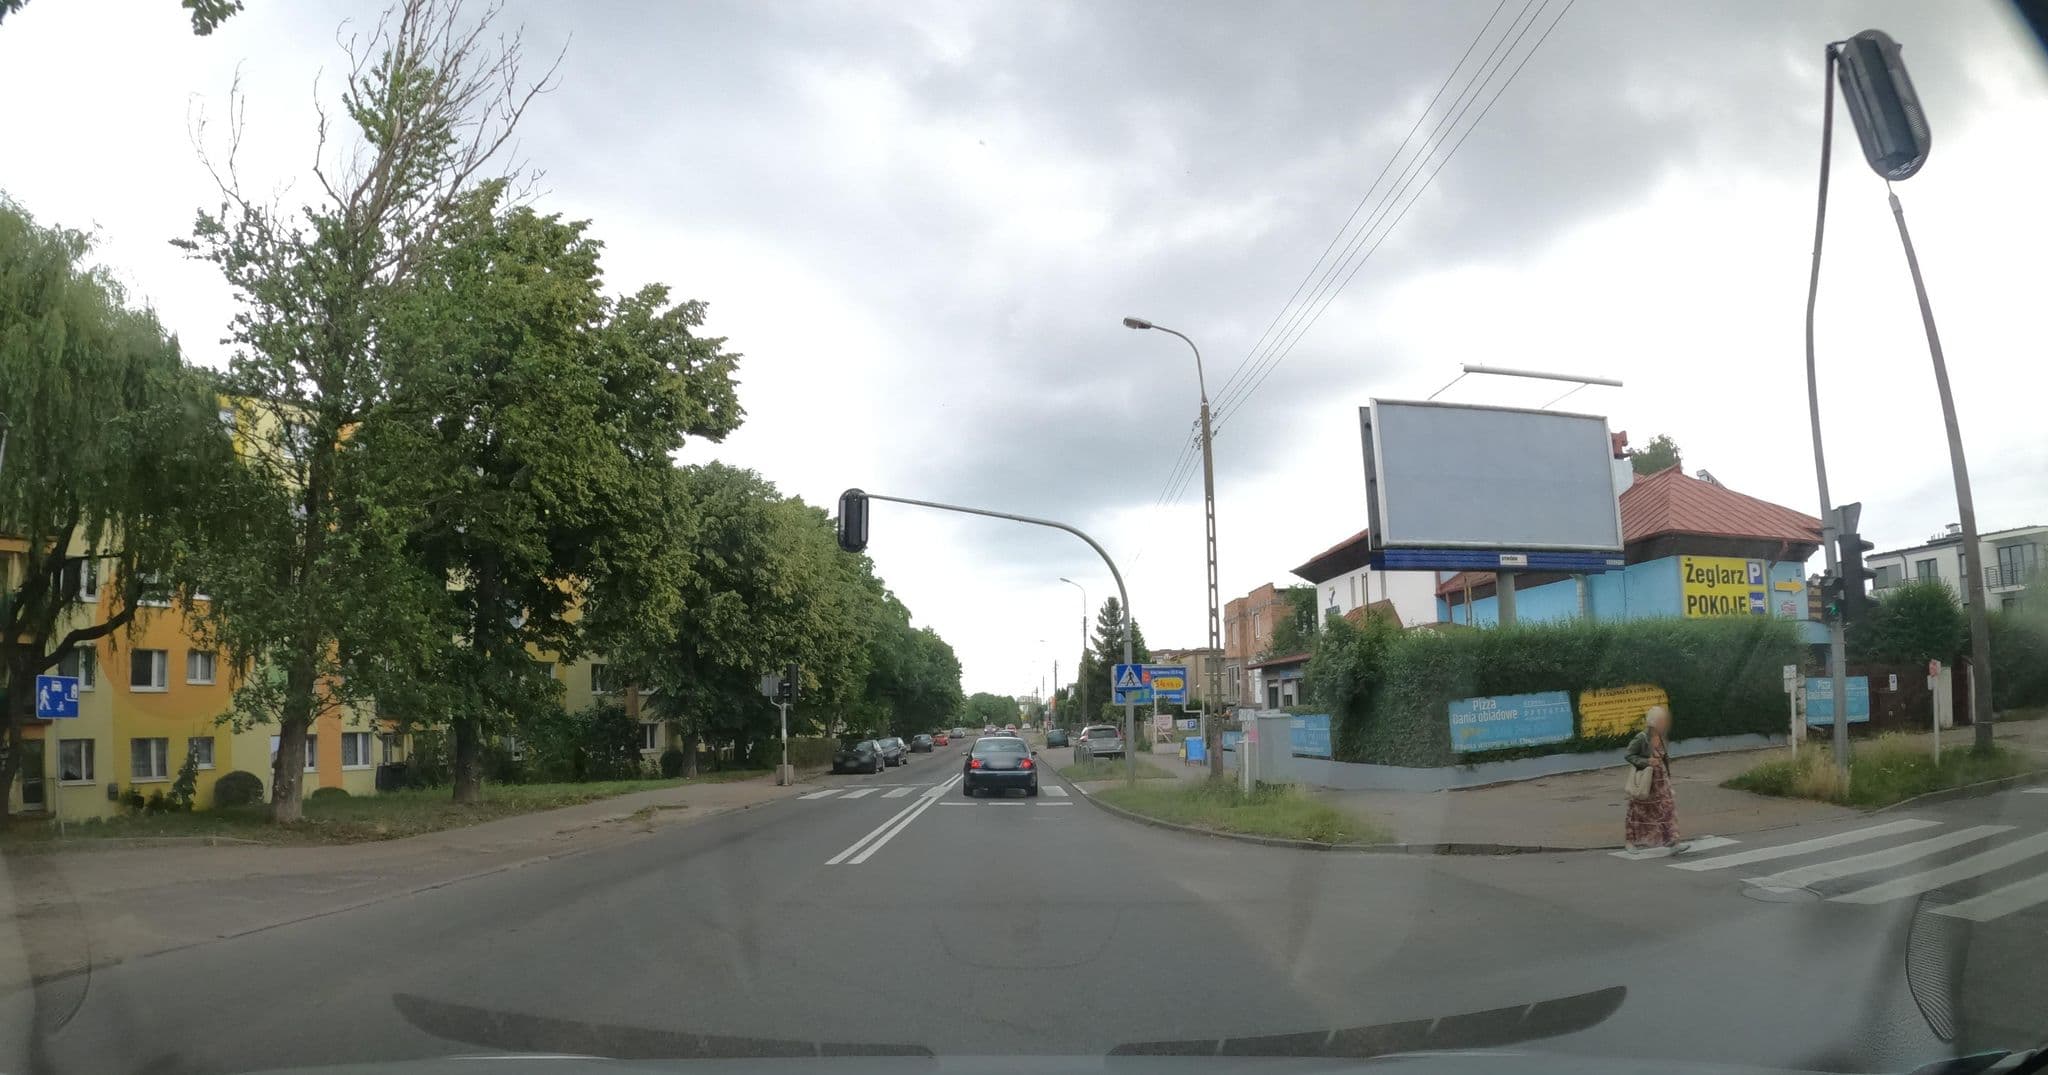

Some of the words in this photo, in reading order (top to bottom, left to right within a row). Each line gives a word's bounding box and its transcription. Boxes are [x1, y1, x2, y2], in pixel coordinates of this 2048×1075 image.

[1685, 558, 1745, 588] Żeglarz
[1687, 595, 1747, 615] POKOJE
[1473, 698, 1497, 711] Pizza
[1478, 709, 1519, 722] obiadowe
